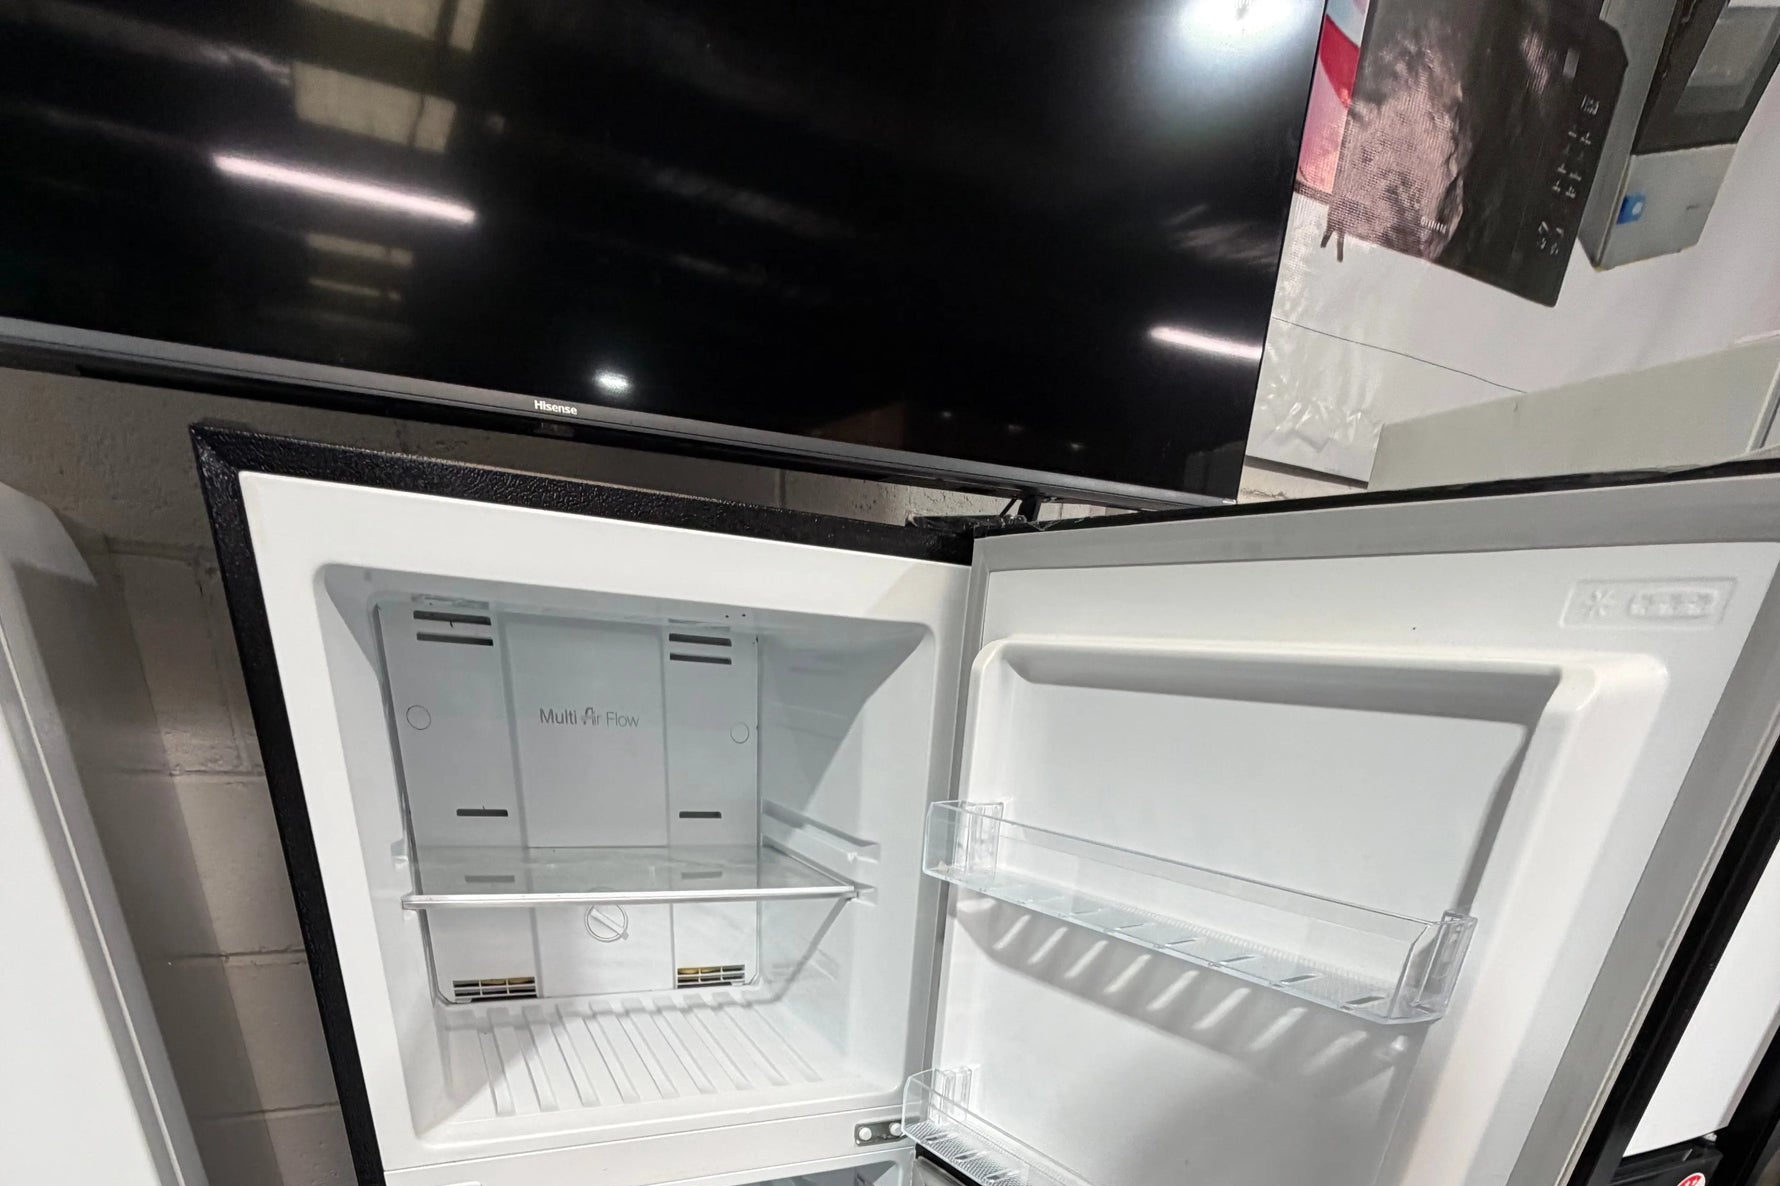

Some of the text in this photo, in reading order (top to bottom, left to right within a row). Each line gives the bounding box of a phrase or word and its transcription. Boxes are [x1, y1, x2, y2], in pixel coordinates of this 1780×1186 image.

[534, 399, 578, 415] Hisense
[539, 707, 578, 725] Multi
[605, 711, 640, 728] Flow
